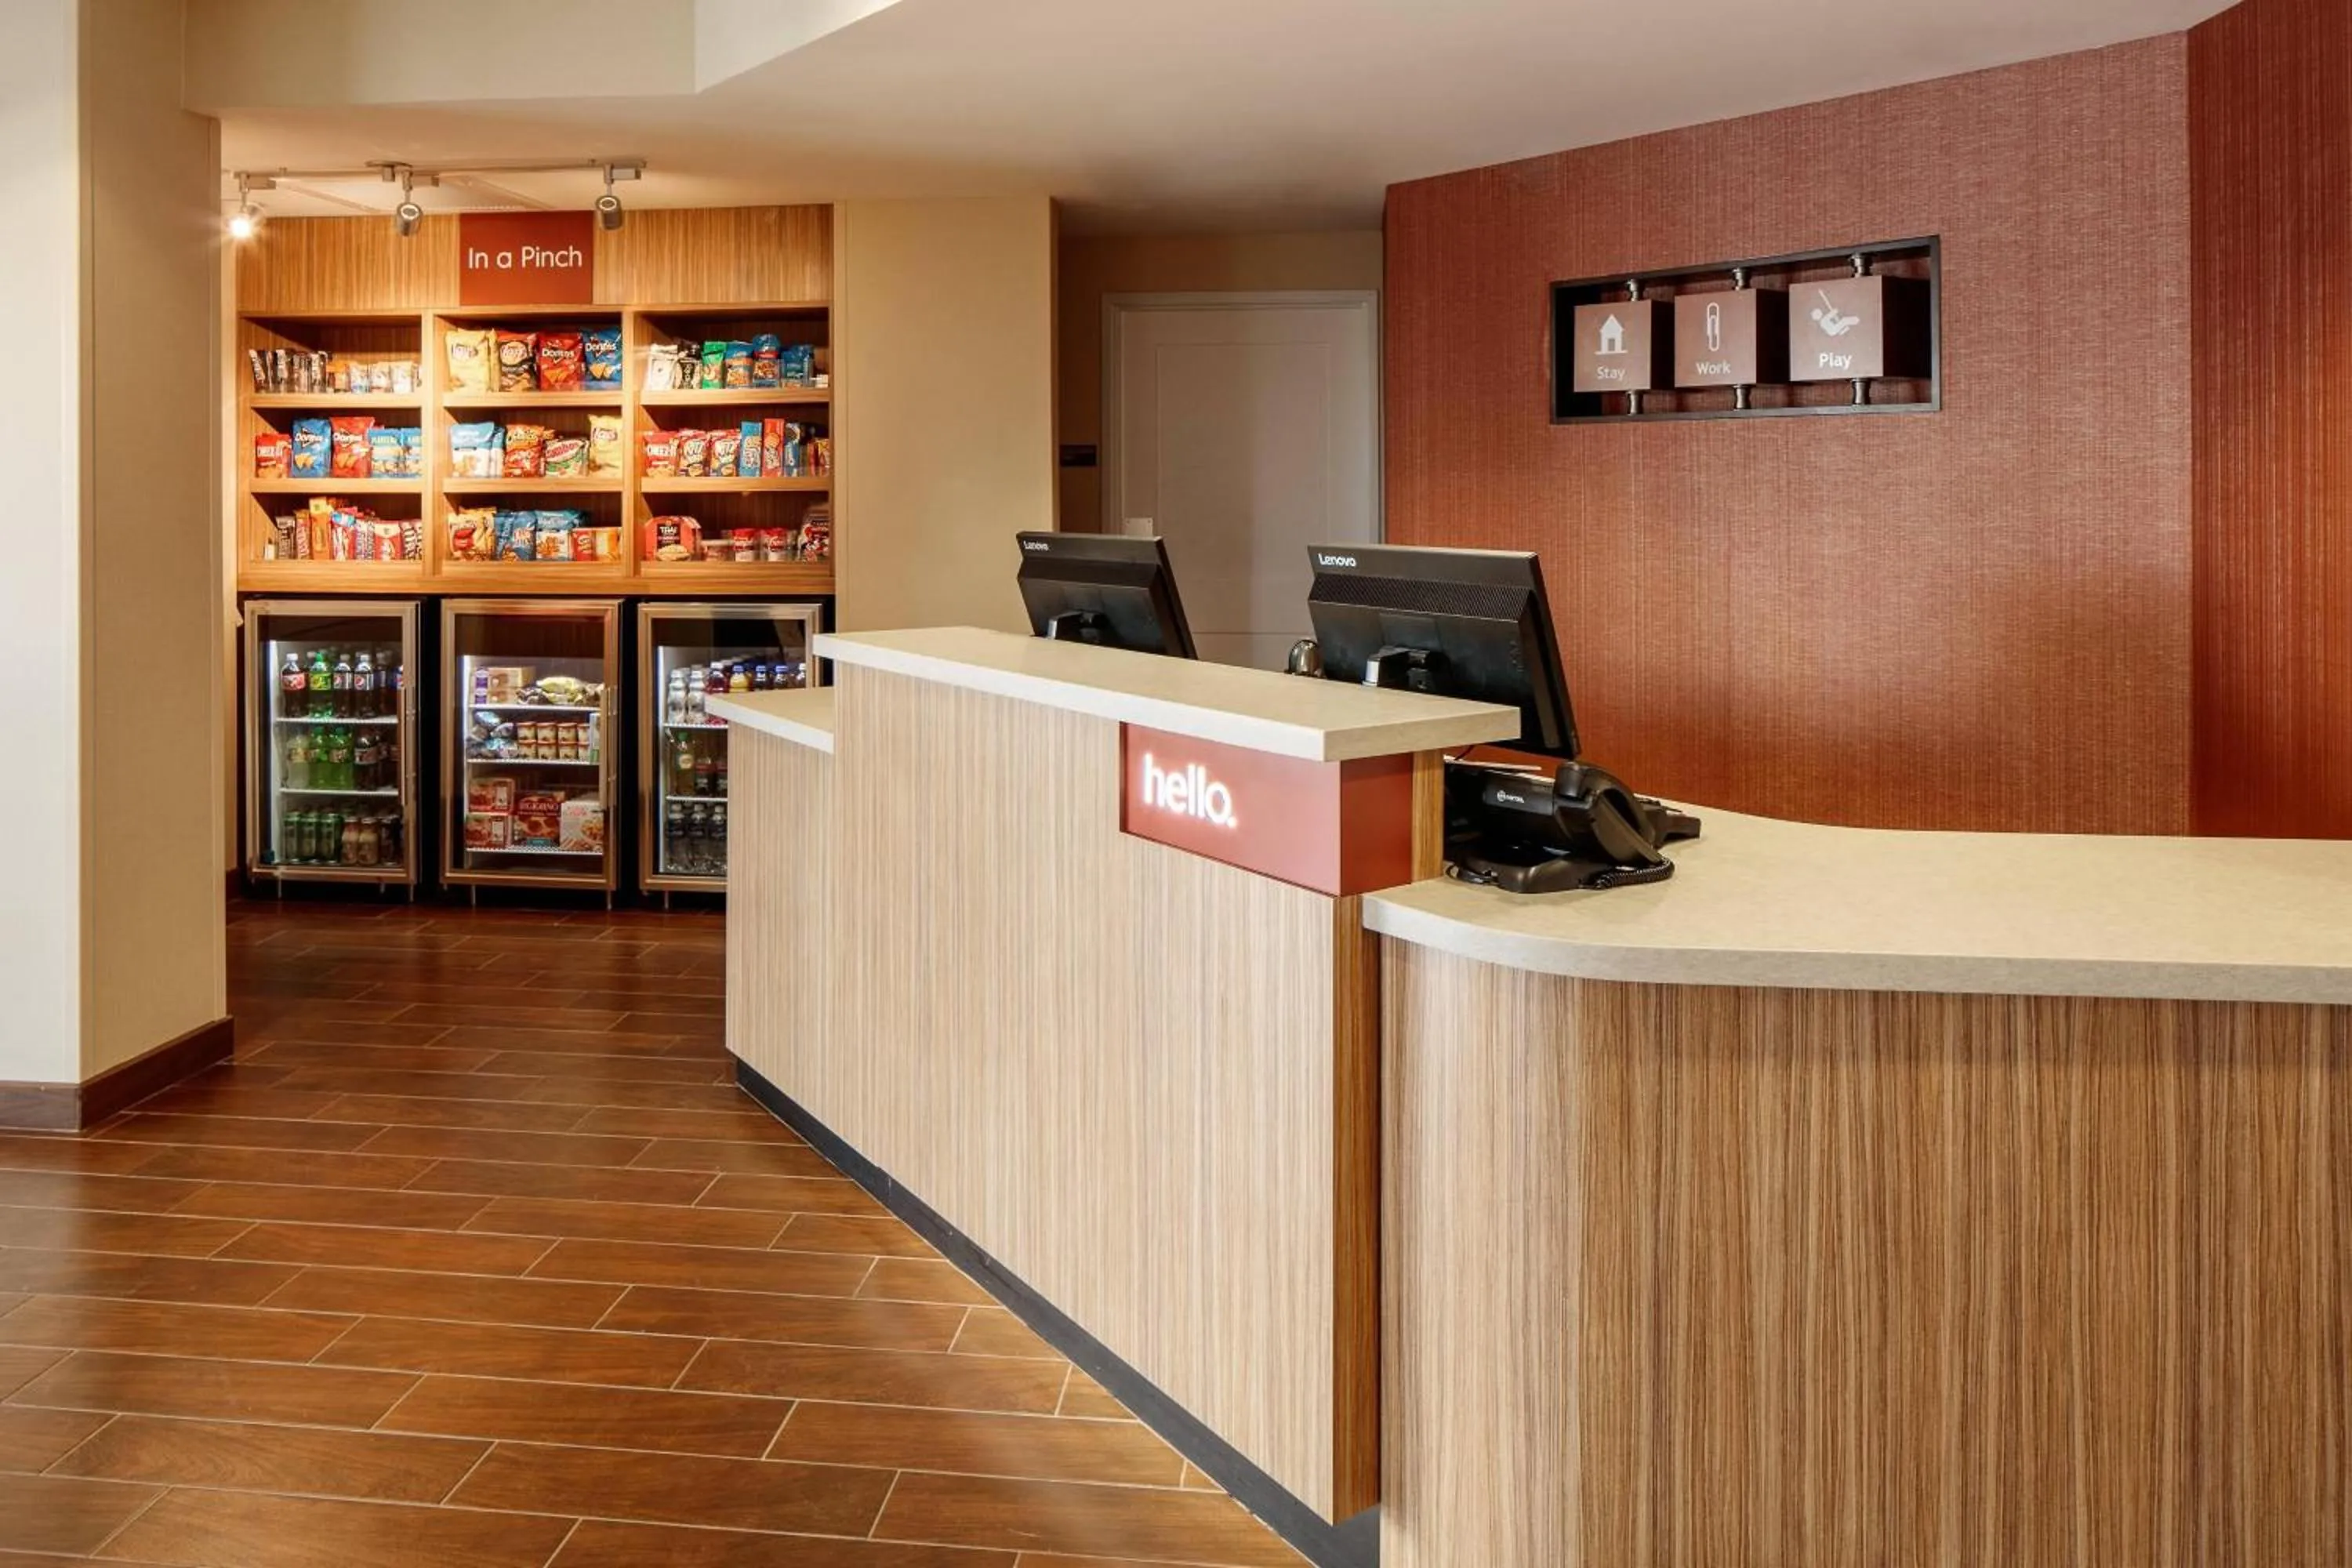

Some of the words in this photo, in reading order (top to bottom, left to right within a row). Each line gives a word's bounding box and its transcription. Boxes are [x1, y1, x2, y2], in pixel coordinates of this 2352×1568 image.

[468, 247, 488, 269] In
[496, 252, 512, 269] a
[521, 245, 583, 268] Pinch
[542, 347, 575, 359] Doritos
[1818, 352, 1853, 369] Play
[1595, 366, 1627, 381] Stay
[1695, 361, 1731, 376] Work
[1023, 540, 1049, 551] Lenovo
[1318, 553, 1356, 567] Lenovo
[1143, 752, 1238, 829] hello.
